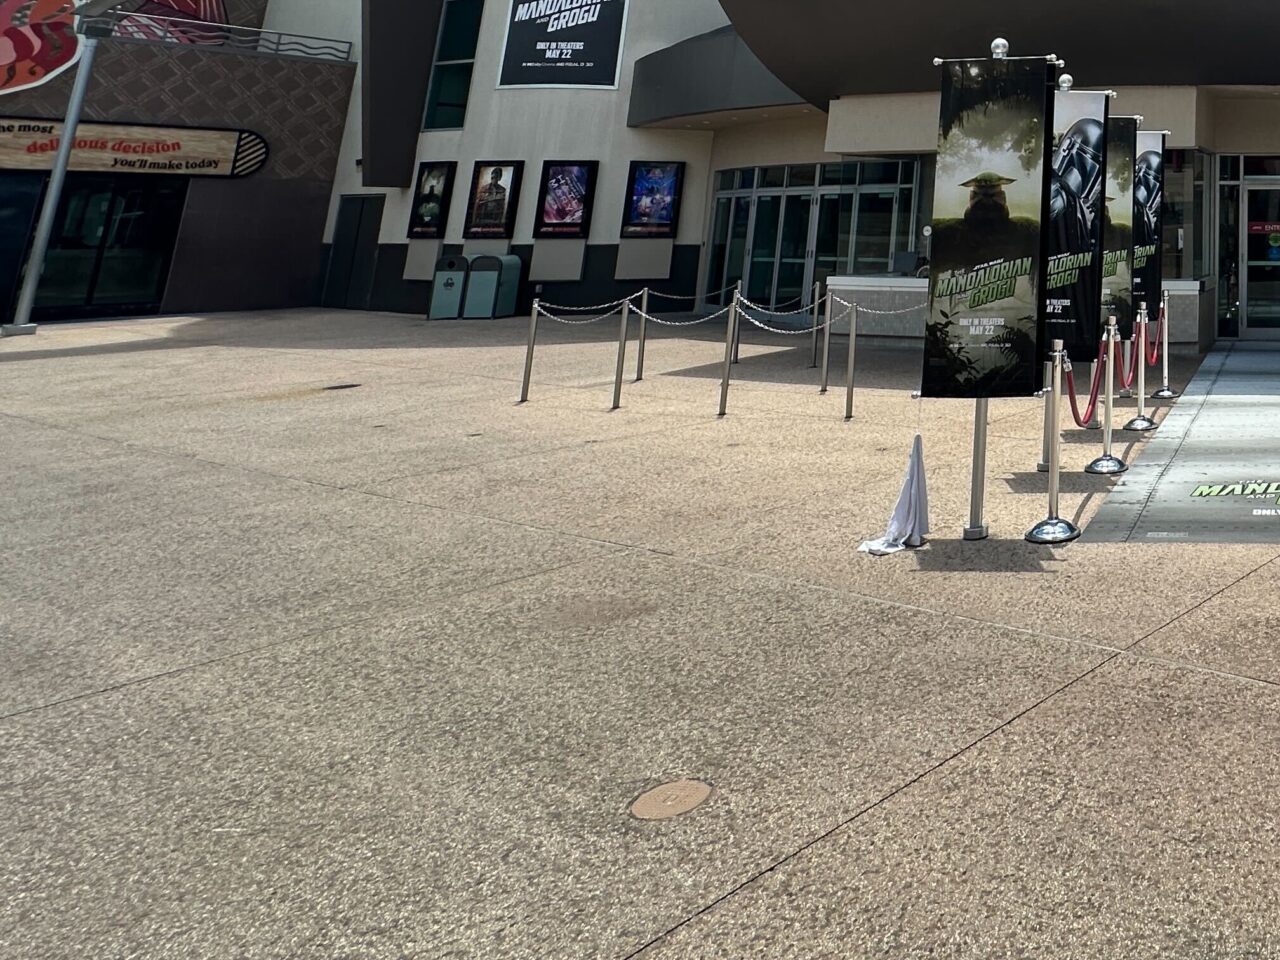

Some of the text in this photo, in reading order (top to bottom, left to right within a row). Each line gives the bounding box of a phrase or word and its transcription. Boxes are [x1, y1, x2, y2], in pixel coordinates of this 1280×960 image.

[547, 4, 601, 32] GROGU
[536, 42, 584, 50] ONLY IN THEATERS
[546, 50, 572, 58] MAY 22
[18, 124, 54, 134] most
[25, 137, 182, 154] deliious decision
[111, 156, 220, 170] you'll make today
[1047, 251, 1092, 274] ALORIAN
[935, 256, 1032, 298] MANDALORIAN
[969, 277, 1016, 308] GROGU
[970, 326, 994, 335] MAY 22
